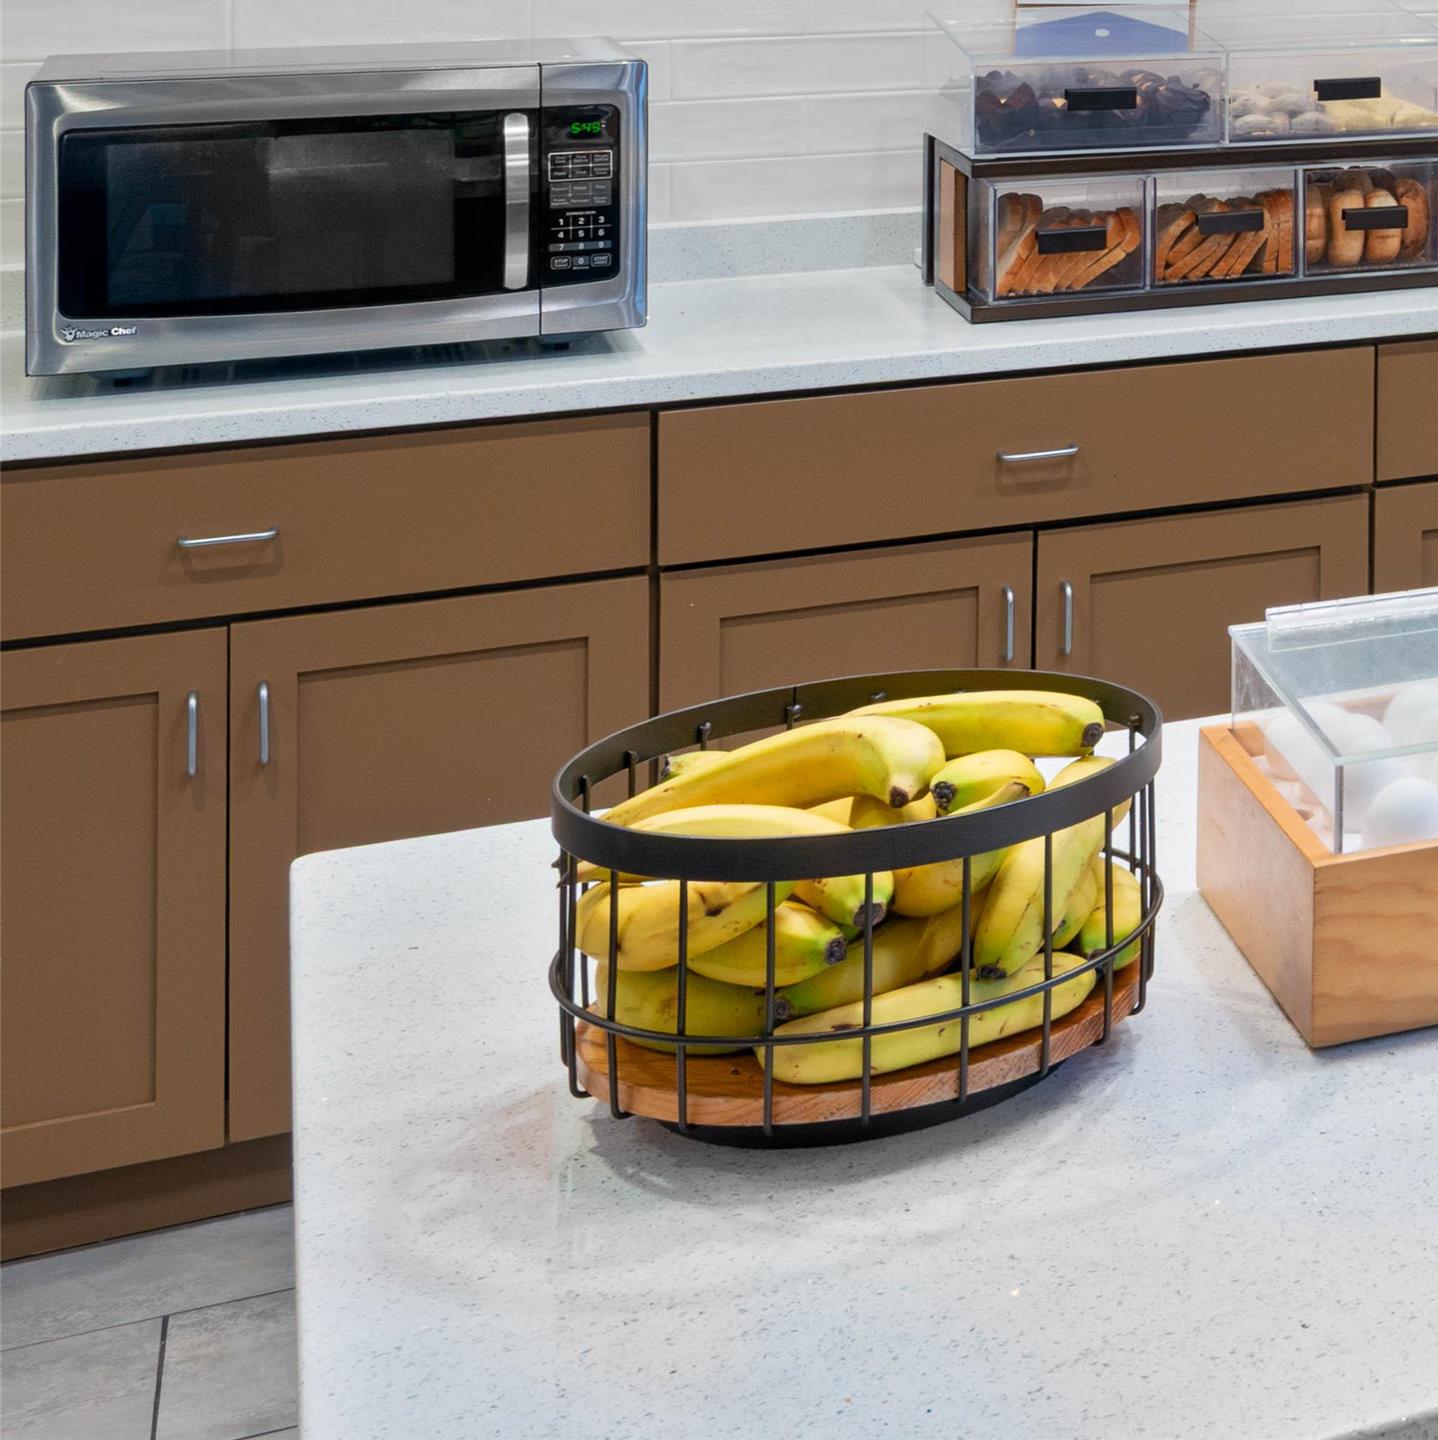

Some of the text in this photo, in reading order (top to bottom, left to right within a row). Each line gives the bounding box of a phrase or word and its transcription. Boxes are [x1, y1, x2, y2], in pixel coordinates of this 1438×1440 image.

[598, 215, 605, 223] 3
[557, 231, 564, 239] 4
[598, 228, 605, 236] 6
[76, 326, 137, 339] Magic Chef
